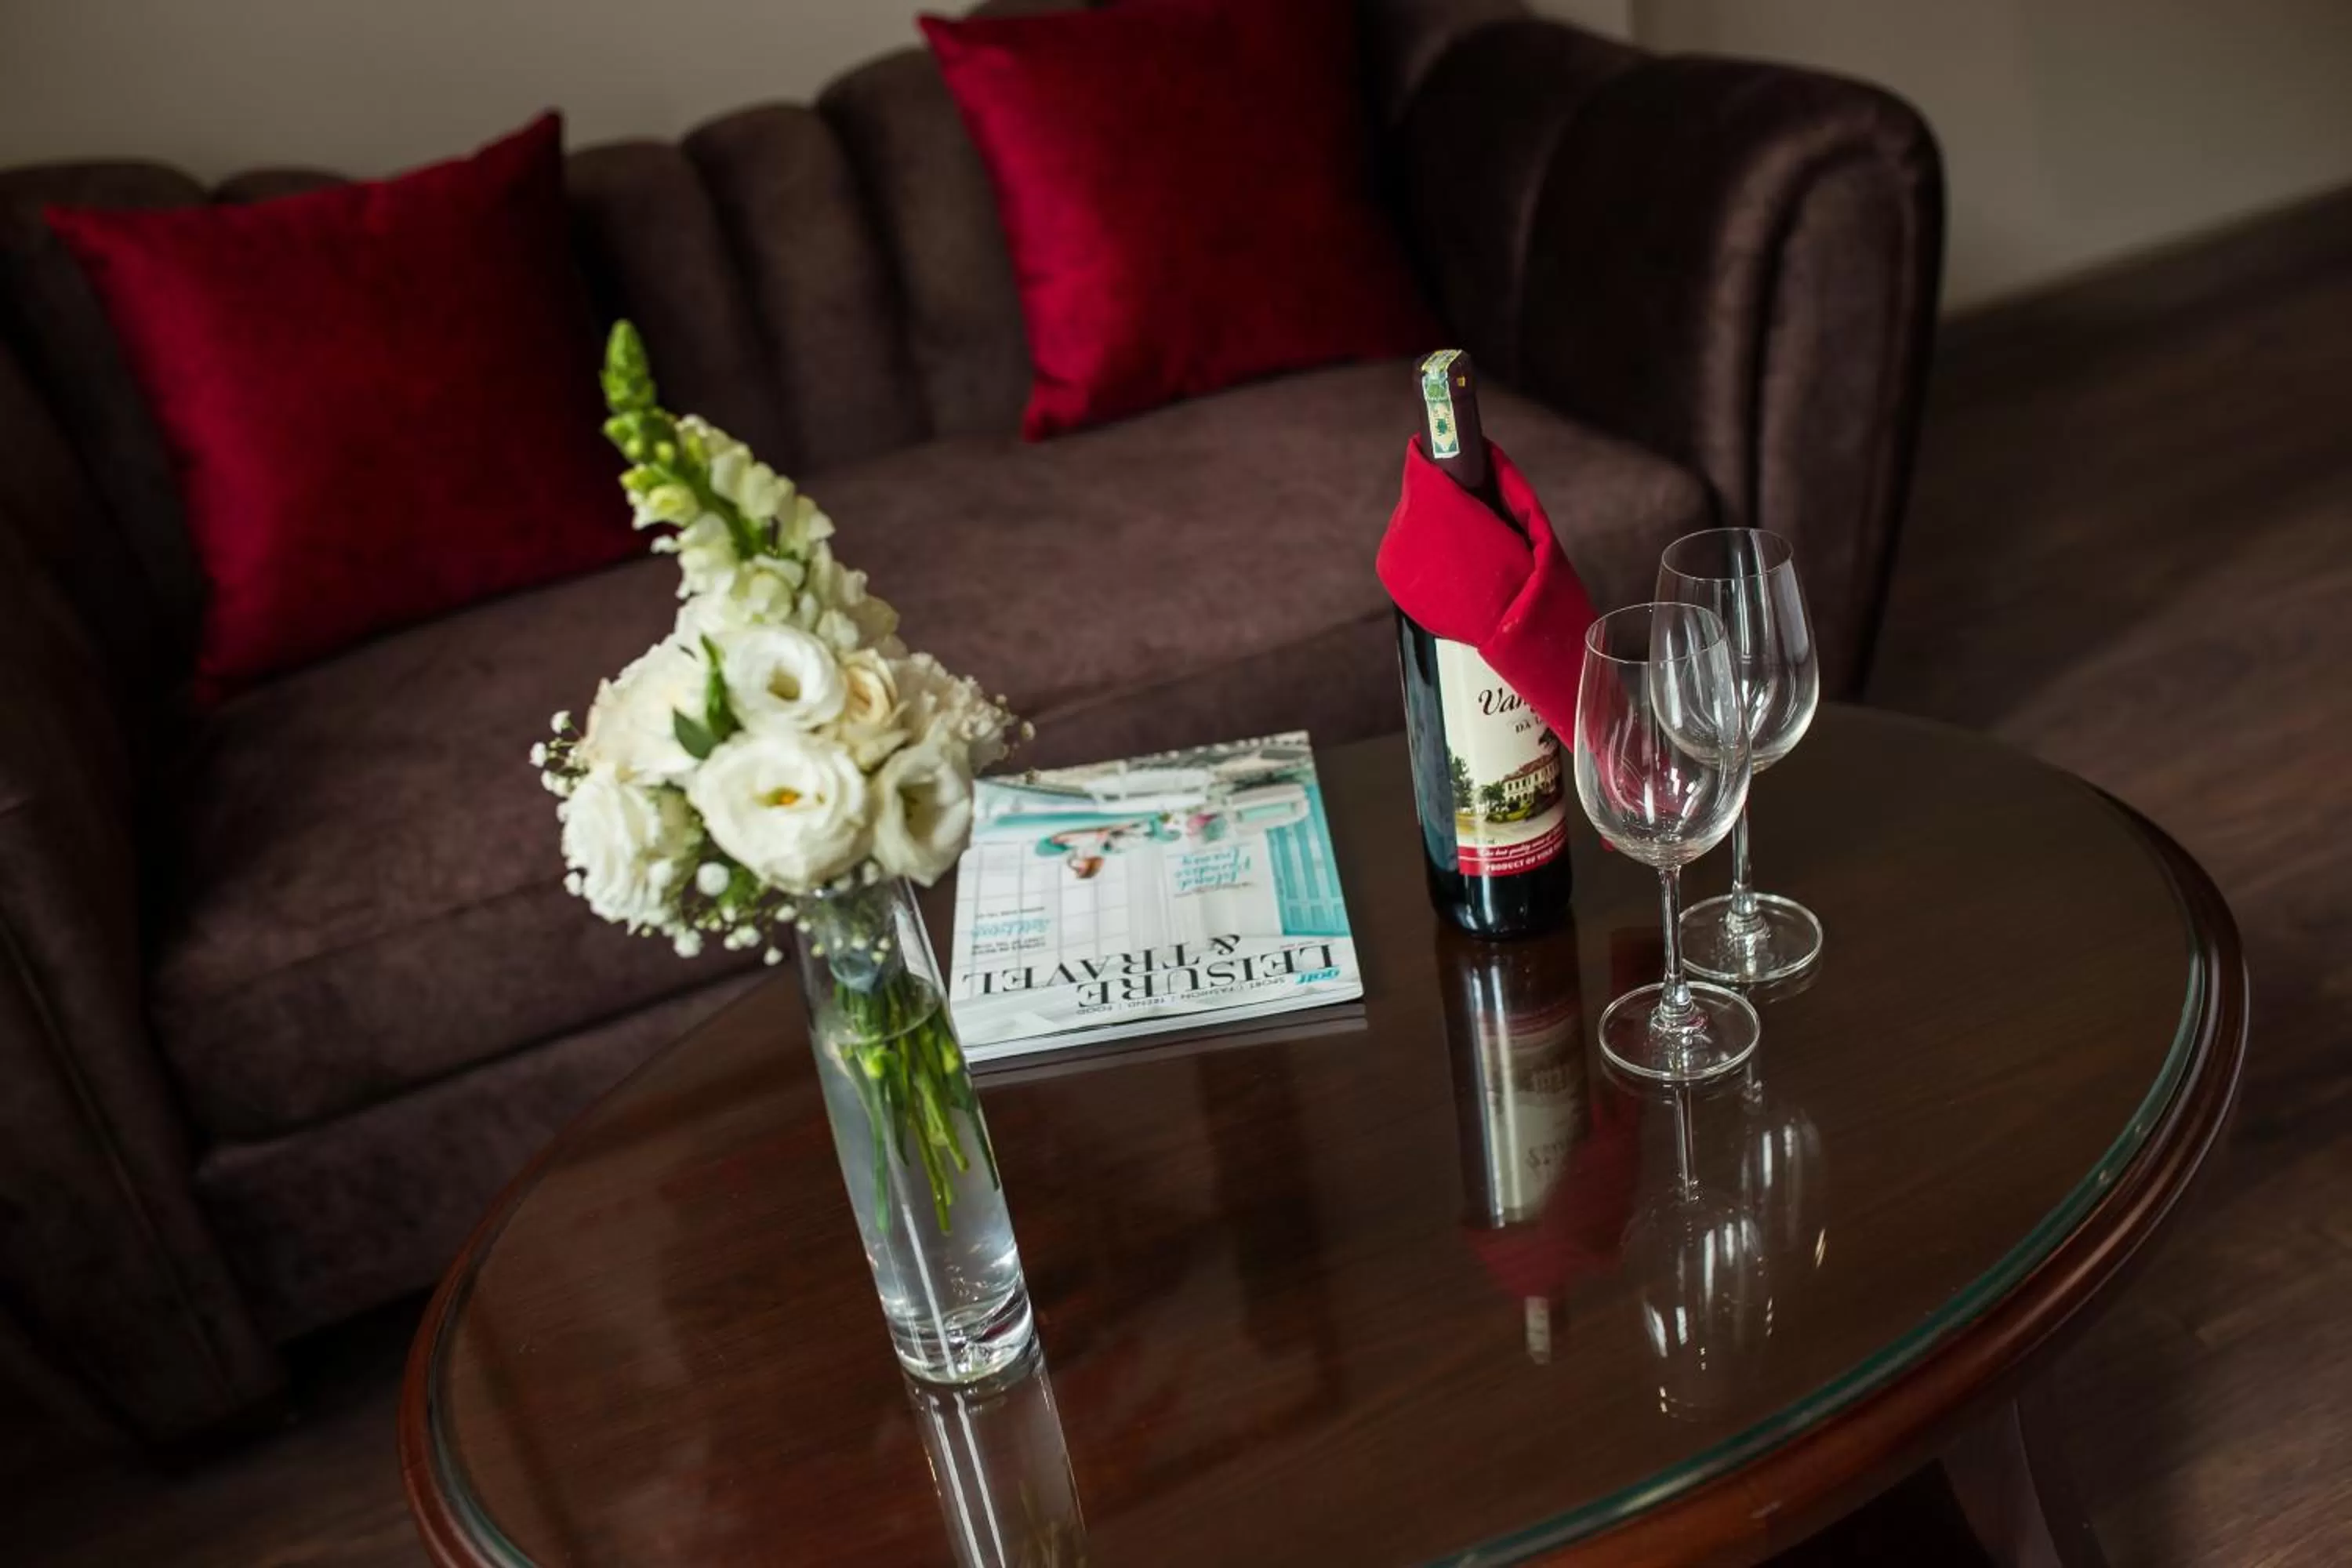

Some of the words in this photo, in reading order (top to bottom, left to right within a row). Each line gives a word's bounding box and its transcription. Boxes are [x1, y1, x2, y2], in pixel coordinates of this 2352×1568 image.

[1208, 934, 1241, 955] &
[962, 942, 1200, 994] TRAVEL
[1076, 944, 1336, 1007] LEISURE
[1250, 976, 1286, 989] SPORT
[1076, 1004, 1113, 1015] FOOD
[1127, 997, 1165, 1009] TREND
